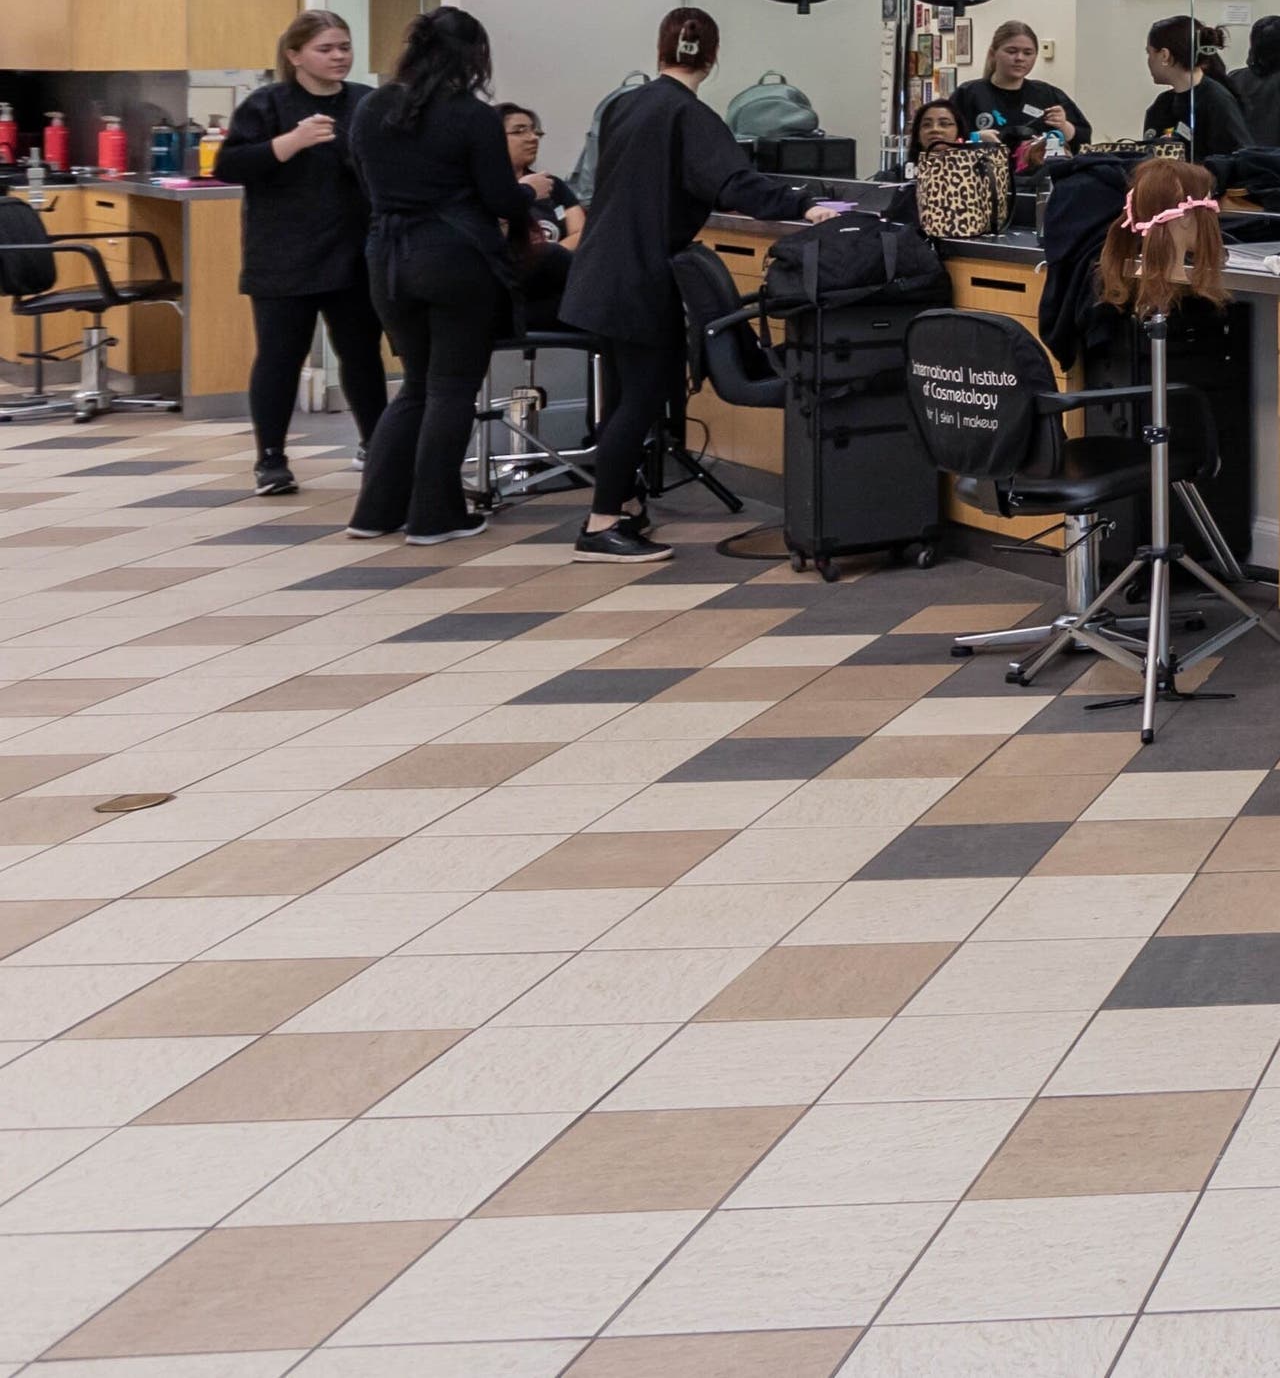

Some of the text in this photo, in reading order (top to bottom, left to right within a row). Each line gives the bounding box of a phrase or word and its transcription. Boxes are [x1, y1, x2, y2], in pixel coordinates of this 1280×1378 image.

[968, 367, 1017, 386] Institute
[931, 382, 998, 410] Cosmetology
[963, 414, 998, 432] makeup
